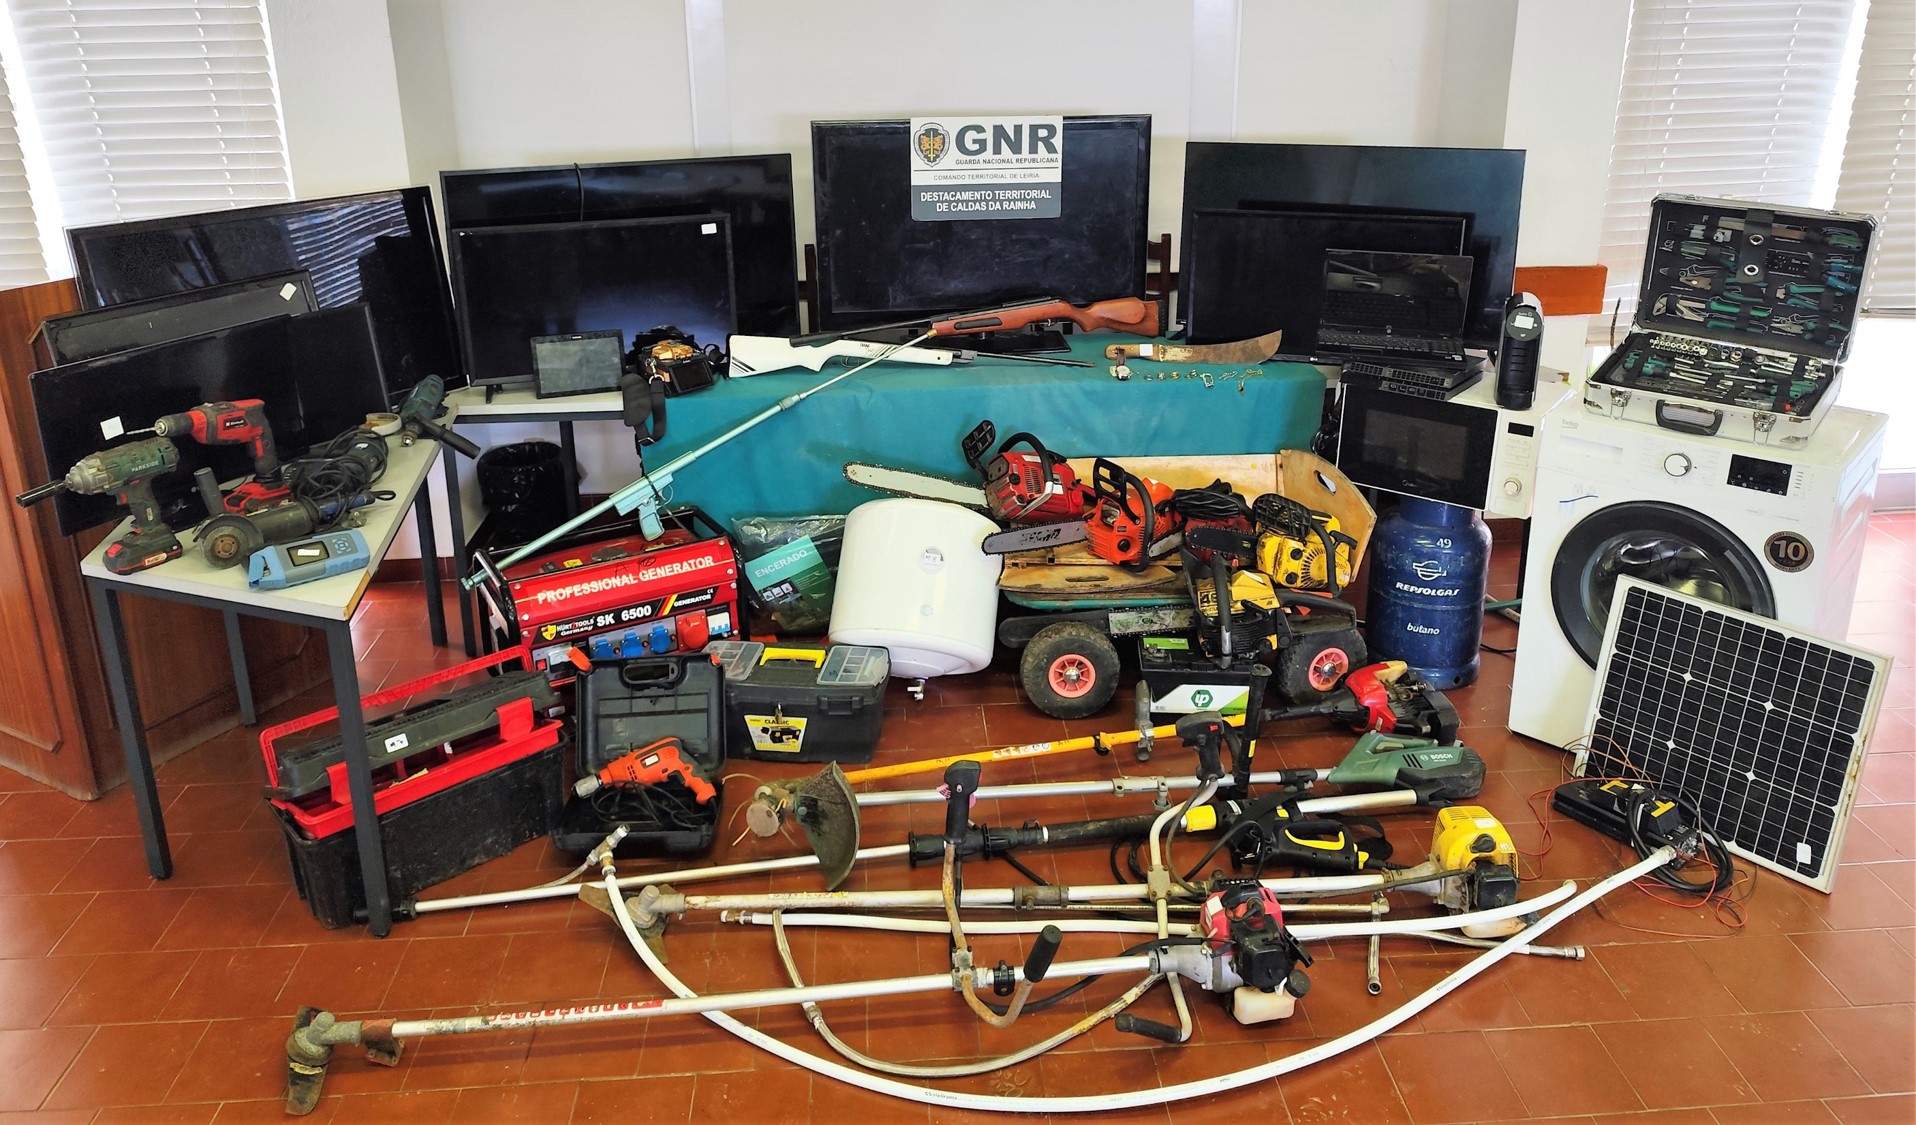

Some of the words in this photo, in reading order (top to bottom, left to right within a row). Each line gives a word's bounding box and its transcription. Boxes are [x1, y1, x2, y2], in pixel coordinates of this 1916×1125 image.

[955, 123, 1059, 157] GNR
[982, 157, 1014, 165] NACIONAL
[920, 190, 993, 202] DESTACAMENTO
[994, 189, 1052, 200] TERRITORIAL
[936, 202, 949, 212] DE
[950, 201, 987, 212] CALDAS
[988, 201, 1001, 211] DA
[1002, 200, 1037, 210] RAINHA
[131, 460, 159, 472] PARKSIDE
[1436, 538, 1452, 549] 49
[1774, 540, 1806, 561] 10
[755, 549, 808, 578] ENCERADO
[536, 573, 638, 605] PROFESSIONAL
[639, 555, 716, 582] GENERATOR
[1395, 581, 1460, 597] REPSOLGAS
[674, 593, 712, 607] GENERATOR
[596, 613, 616, 627] SK
[621, 605, 652, 621] 6500
[560, 625, 593, 637] Germany
[1406, 622, 1441, 635] butano
